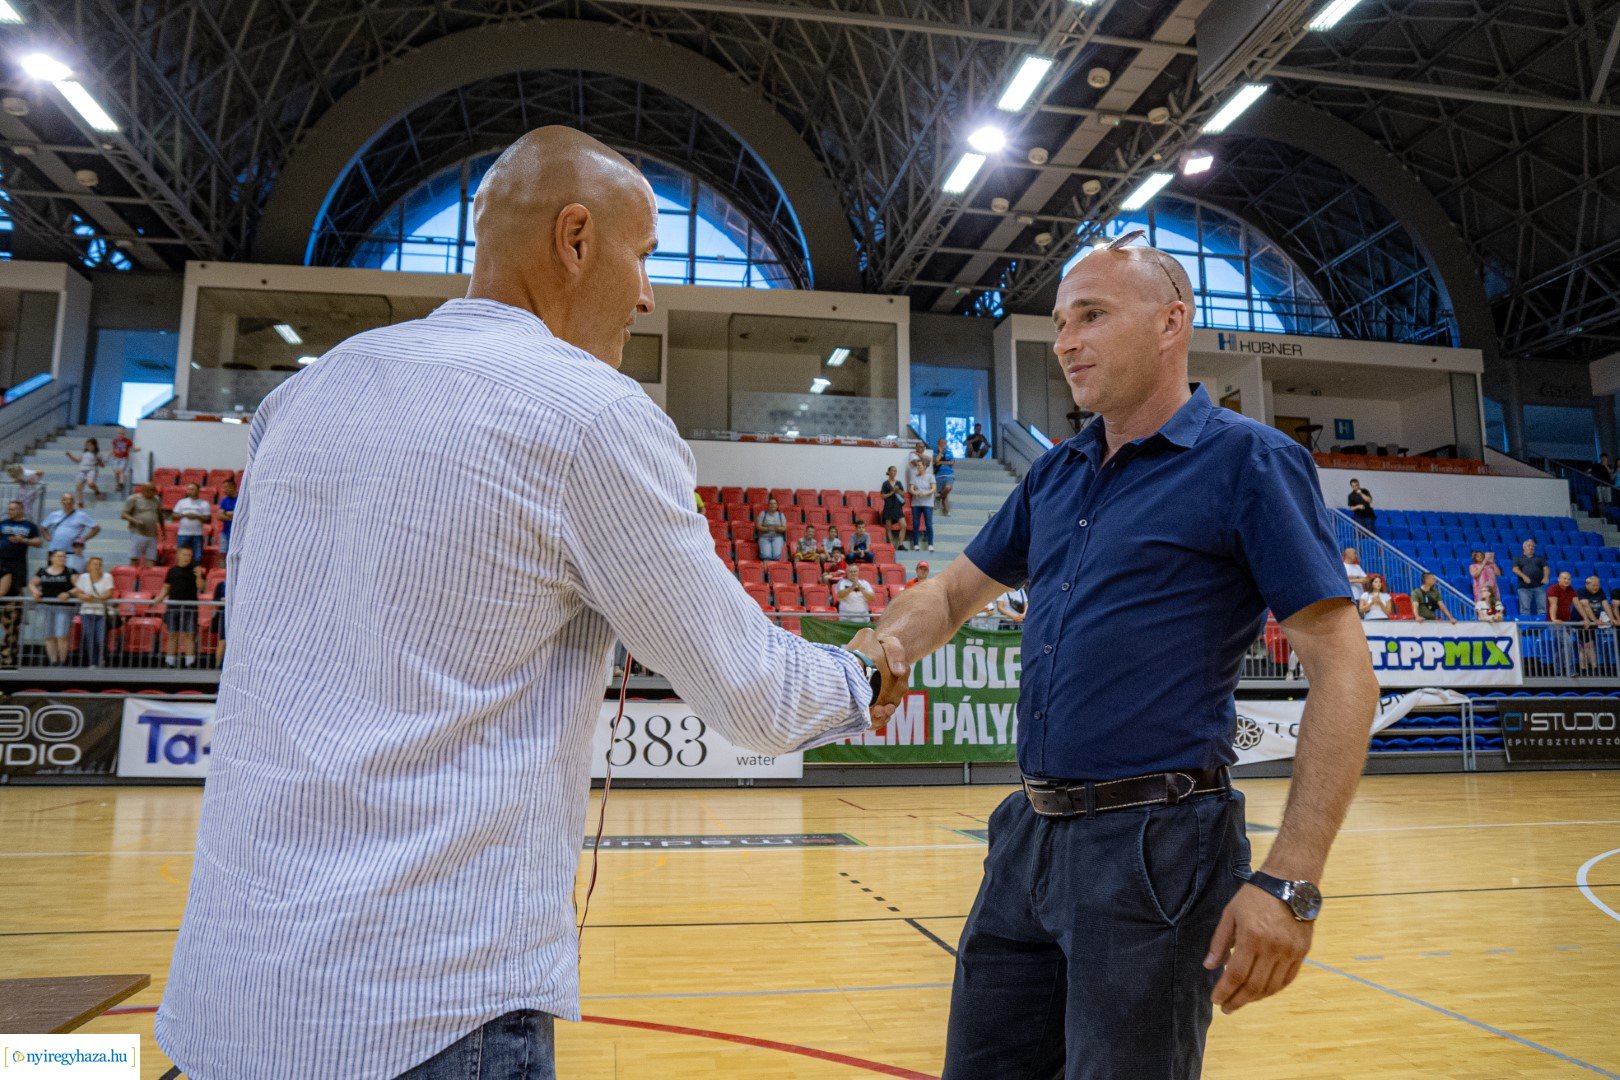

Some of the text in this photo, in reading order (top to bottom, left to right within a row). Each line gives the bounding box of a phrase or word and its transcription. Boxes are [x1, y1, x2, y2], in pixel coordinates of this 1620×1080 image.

[1239, 341, 1303, 356] HÜBNER
[933, 695, 1017, 745] PÁLY
[606, 715, 707, 767] 383
[0, 743, 81, 765] DIO
[736, 756, 777, 766] water
